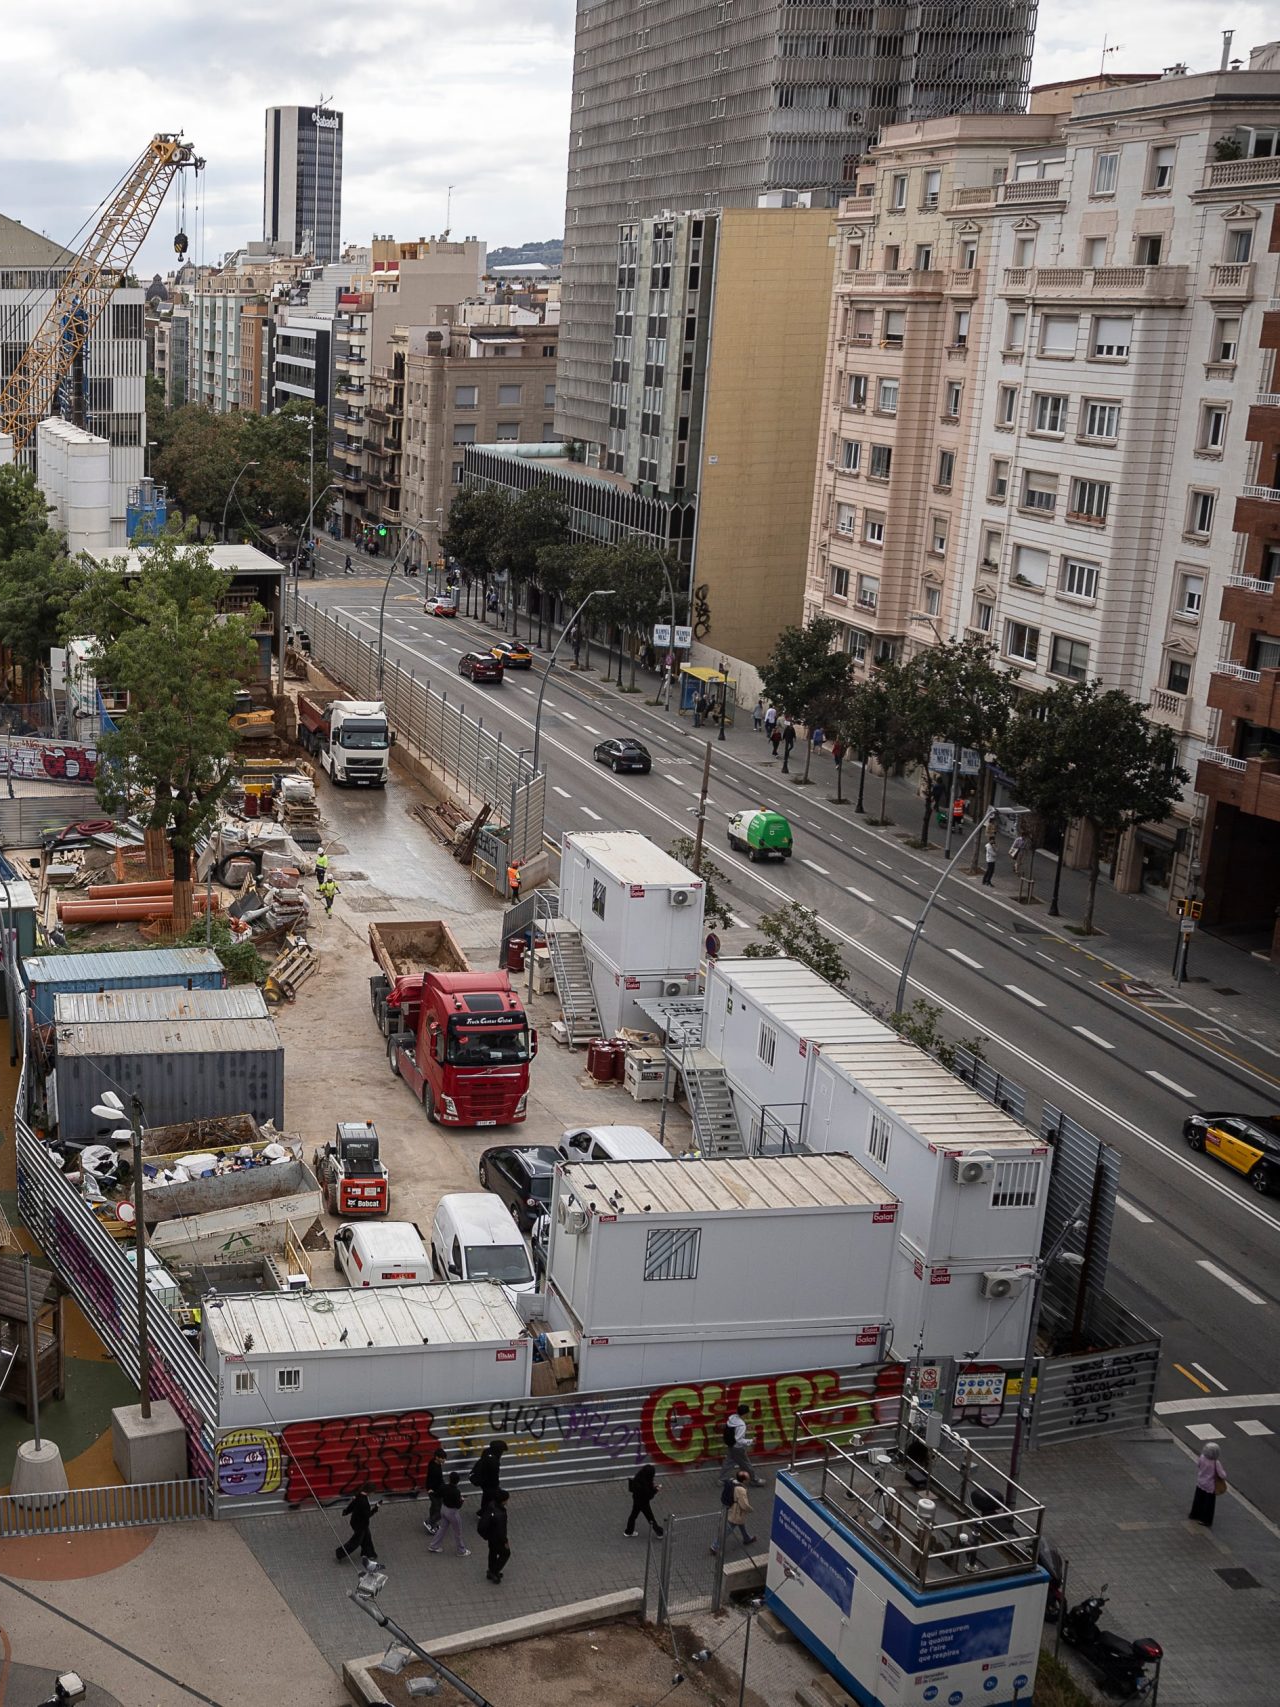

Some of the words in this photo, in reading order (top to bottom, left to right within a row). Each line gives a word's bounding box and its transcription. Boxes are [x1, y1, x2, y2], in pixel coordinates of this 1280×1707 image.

[316, 115, 339, 128] Sabadell
[655, 757, 693, 765] BUS
[938, 1624, 970, 1635] mesurem
[928, 1634, 954, 1645] qualitat
[918, 1655, 931, 1663] que
[932, 1649, 960, 1659] respires
[919, 1647, 928, 1655] de
